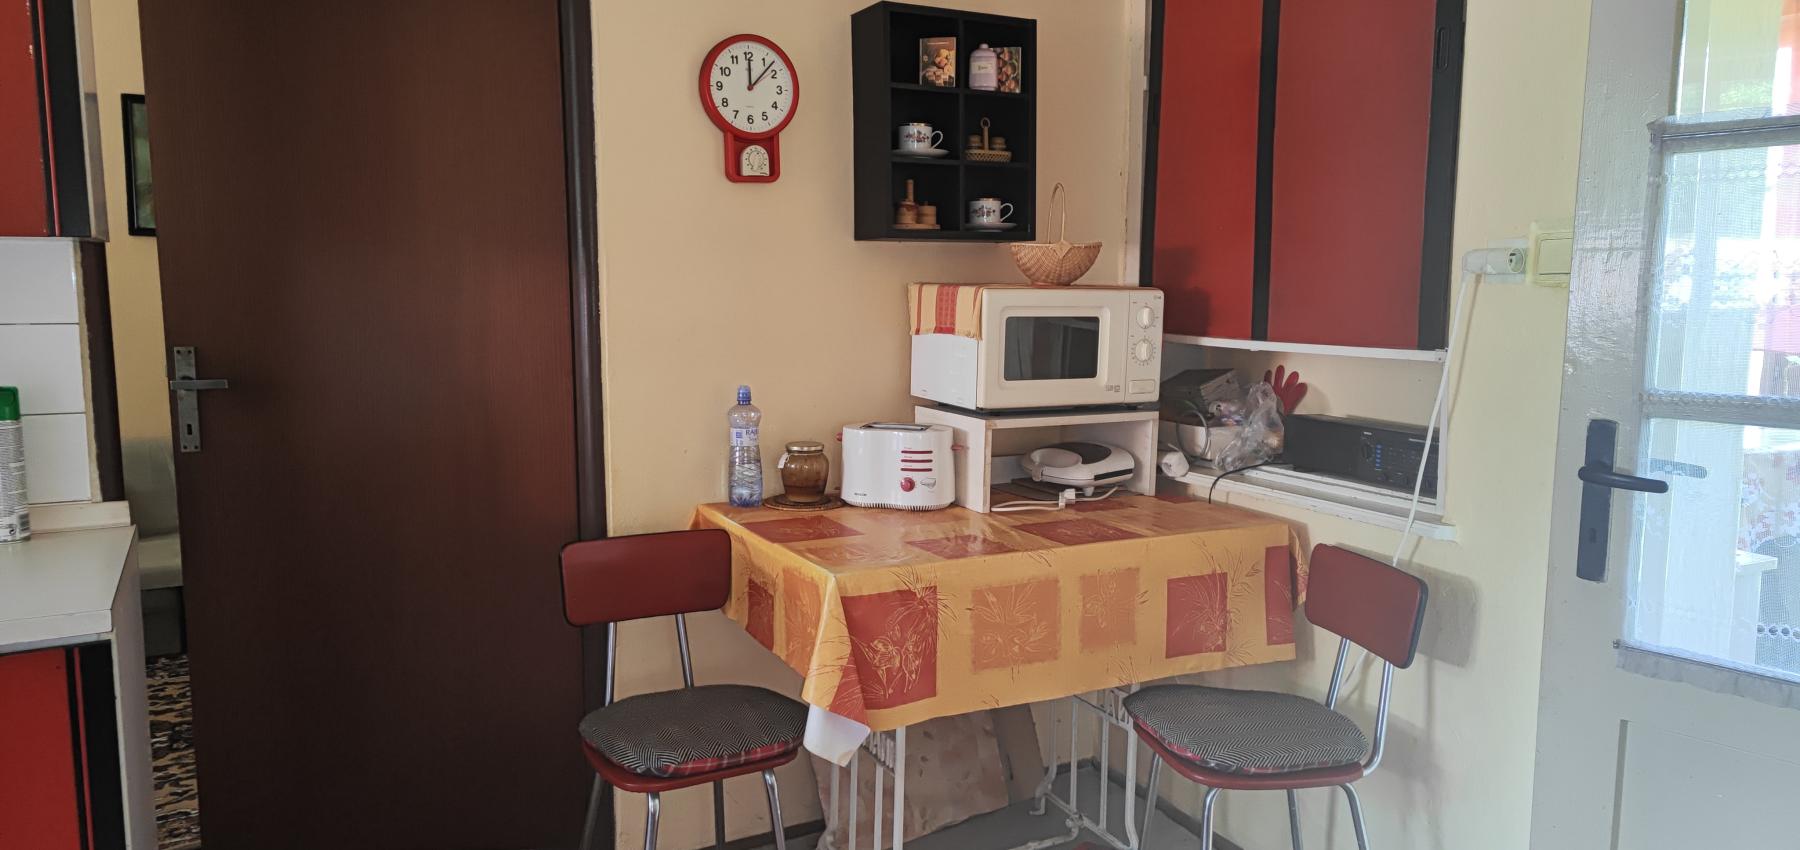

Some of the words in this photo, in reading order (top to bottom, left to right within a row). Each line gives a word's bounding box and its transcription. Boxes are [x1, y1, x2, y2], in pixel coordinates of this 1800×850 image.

[731, 55, 738, 64] 11
[744, 52, 753, 62] 12
[720, 67, 731, 76] 10
[771, 70, 777, 79] 2
[716, 81, 723, 91] 9
[776, 85, 782, 95] 3
[722, 98, 728, 107] 8
[771, 101, 778, 110] 4
[733, 110, 739, 119] 7
[762, 112, 768, 121] 5
[747, 115, 754, 124] 6
